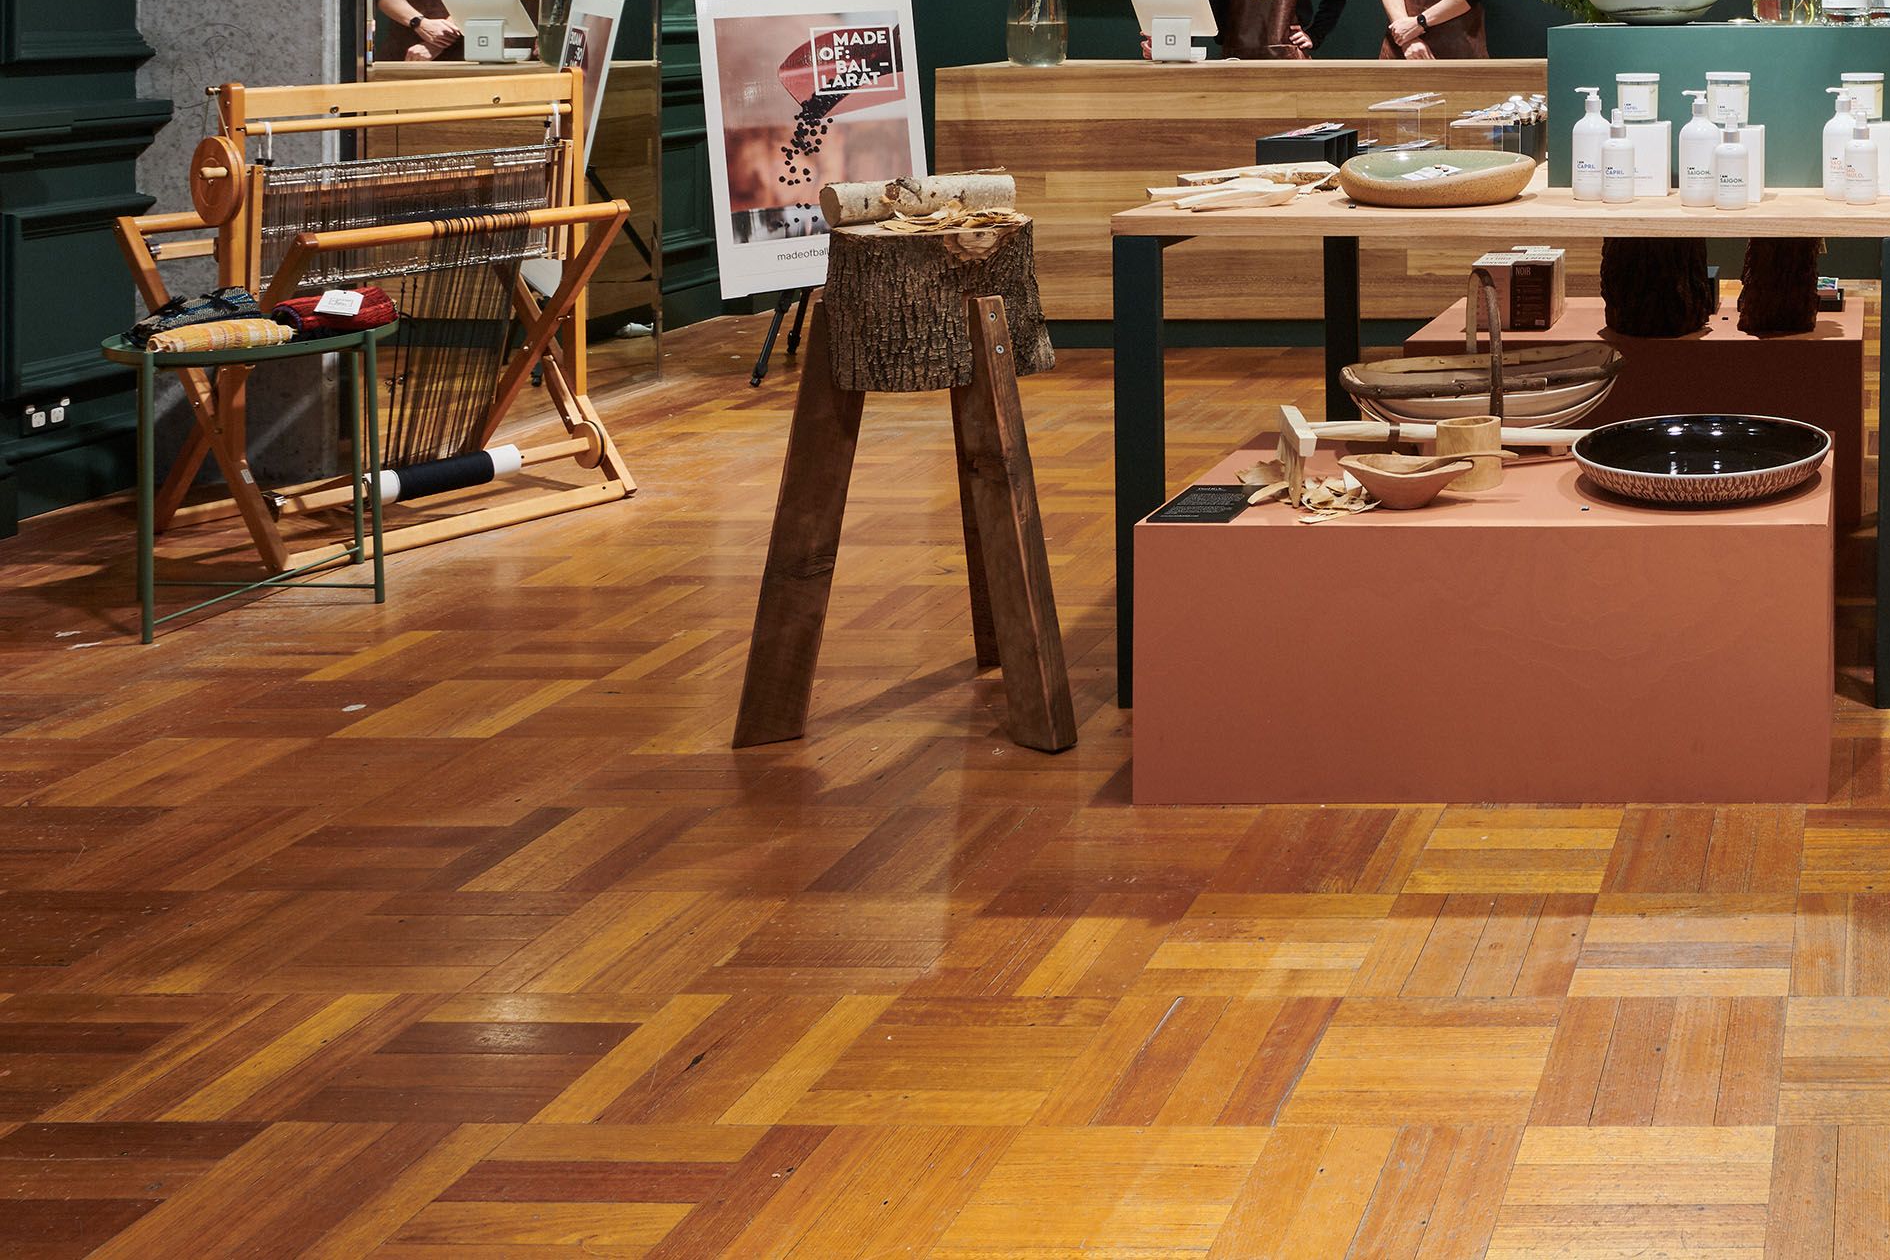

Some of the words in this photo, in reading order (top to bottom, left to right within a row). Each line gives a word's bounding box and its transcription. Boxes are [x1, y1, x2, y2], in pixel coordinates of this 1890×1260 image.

[832, 30, 887, 46] MADE
[819, 46, 850, 61] OF:
[836, 59, 871, 74] BAL
[821, 71, 881, 89] LARAT
